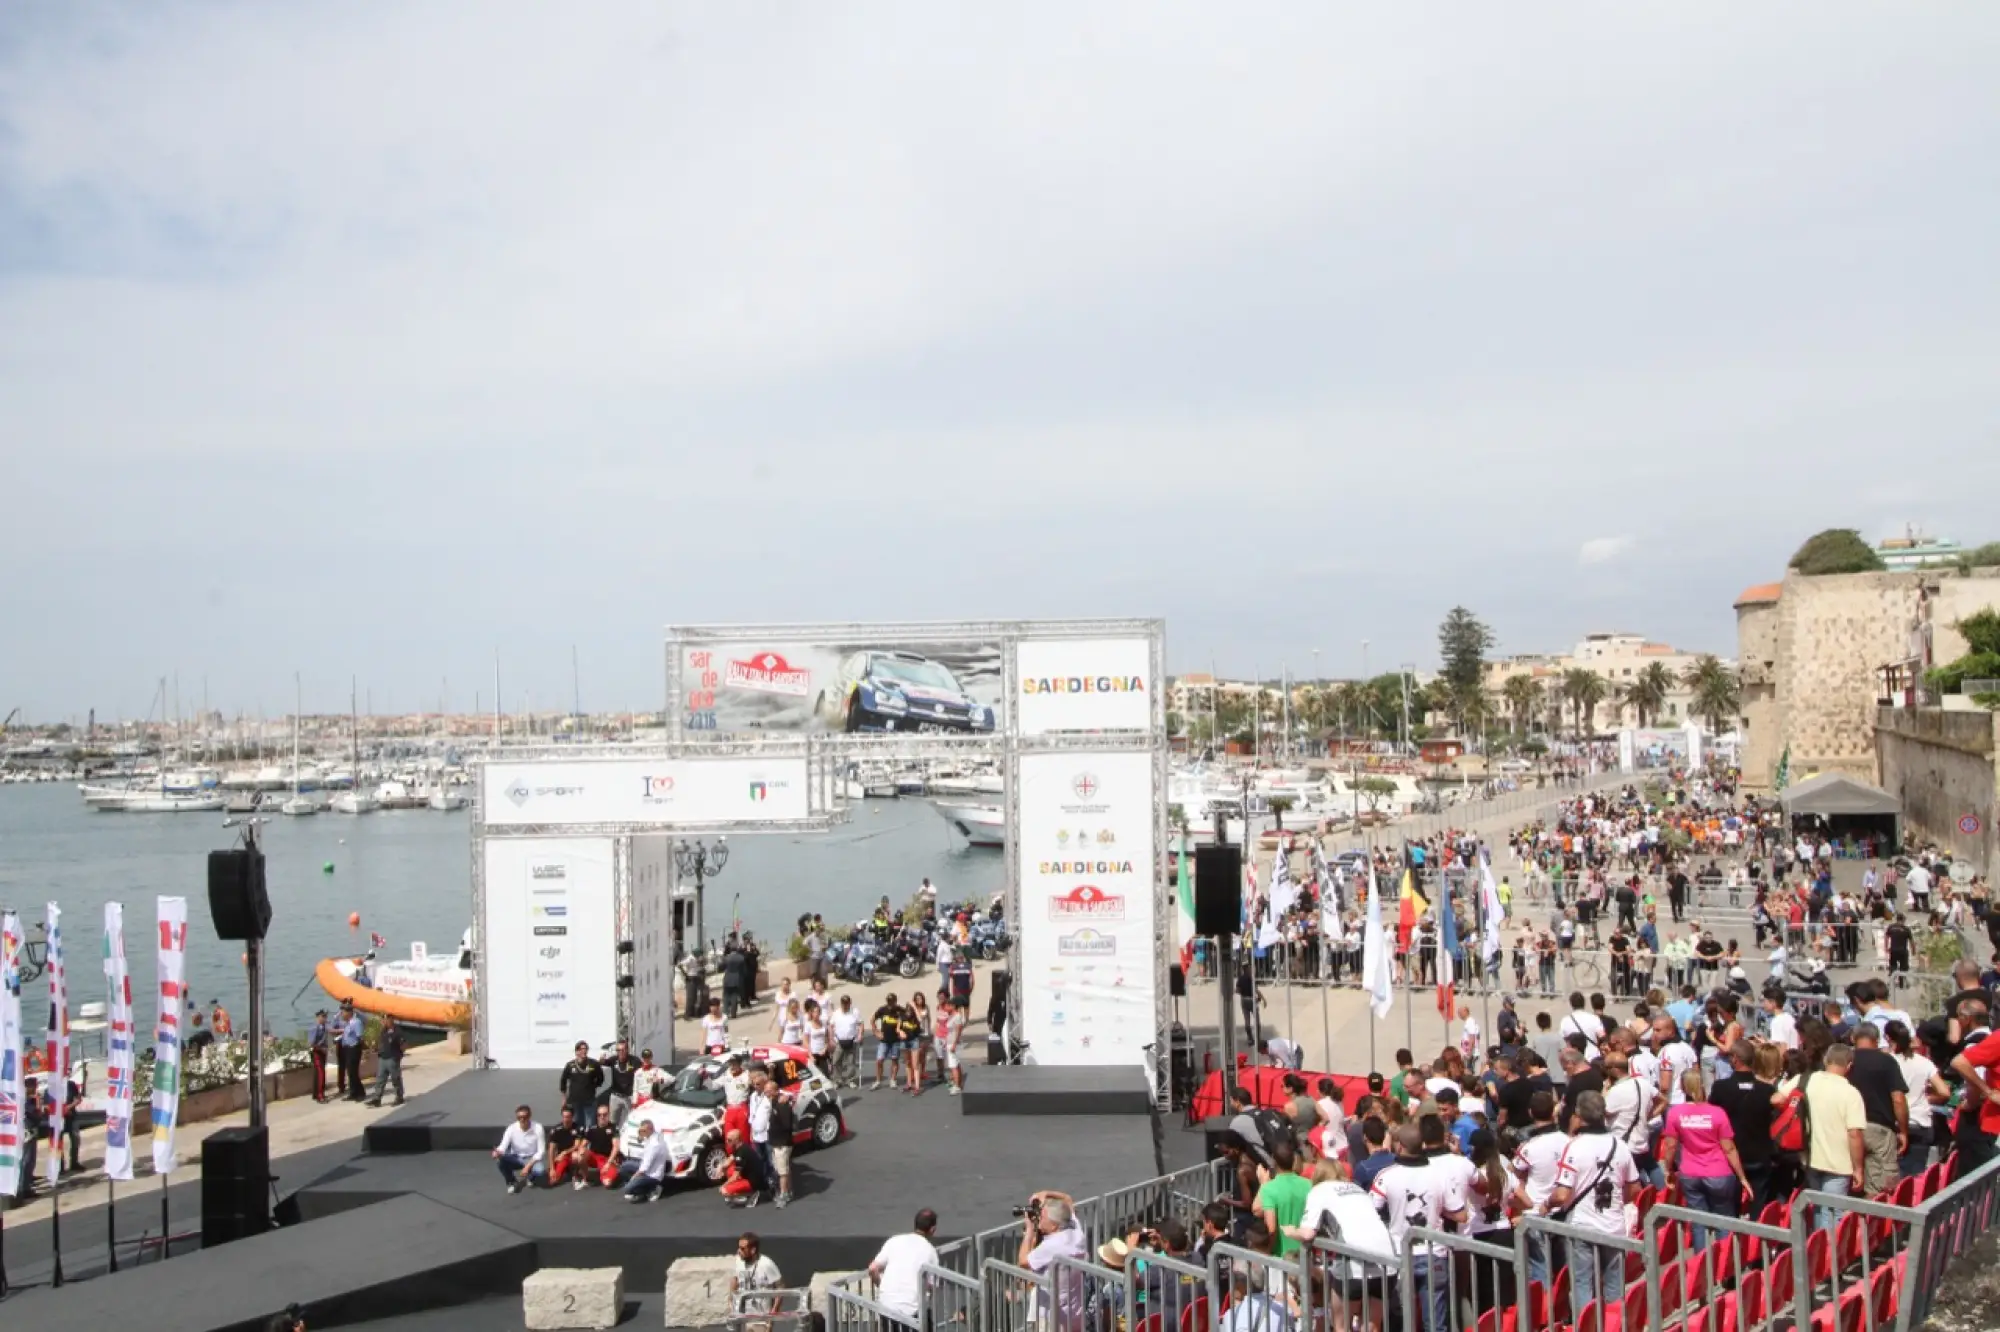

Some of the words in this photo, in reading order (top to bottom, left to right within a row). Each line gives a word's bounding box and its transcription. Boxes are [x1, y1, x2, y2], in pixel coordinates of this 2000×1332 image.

[1023, 676, 1144, 693] SARDEGNA
[688, 713, 717, 729] 2016
[535, 787, 585, 796] SPORT
[1040, 861, 1133, 874] SARDEGNA
[383, 975, 416, 988] GUARDIA
[420, 981, 463, 995] COSTIERA
[702, 1279, 712, 1298] 1
[563, 1294, 576, 1313] 2
